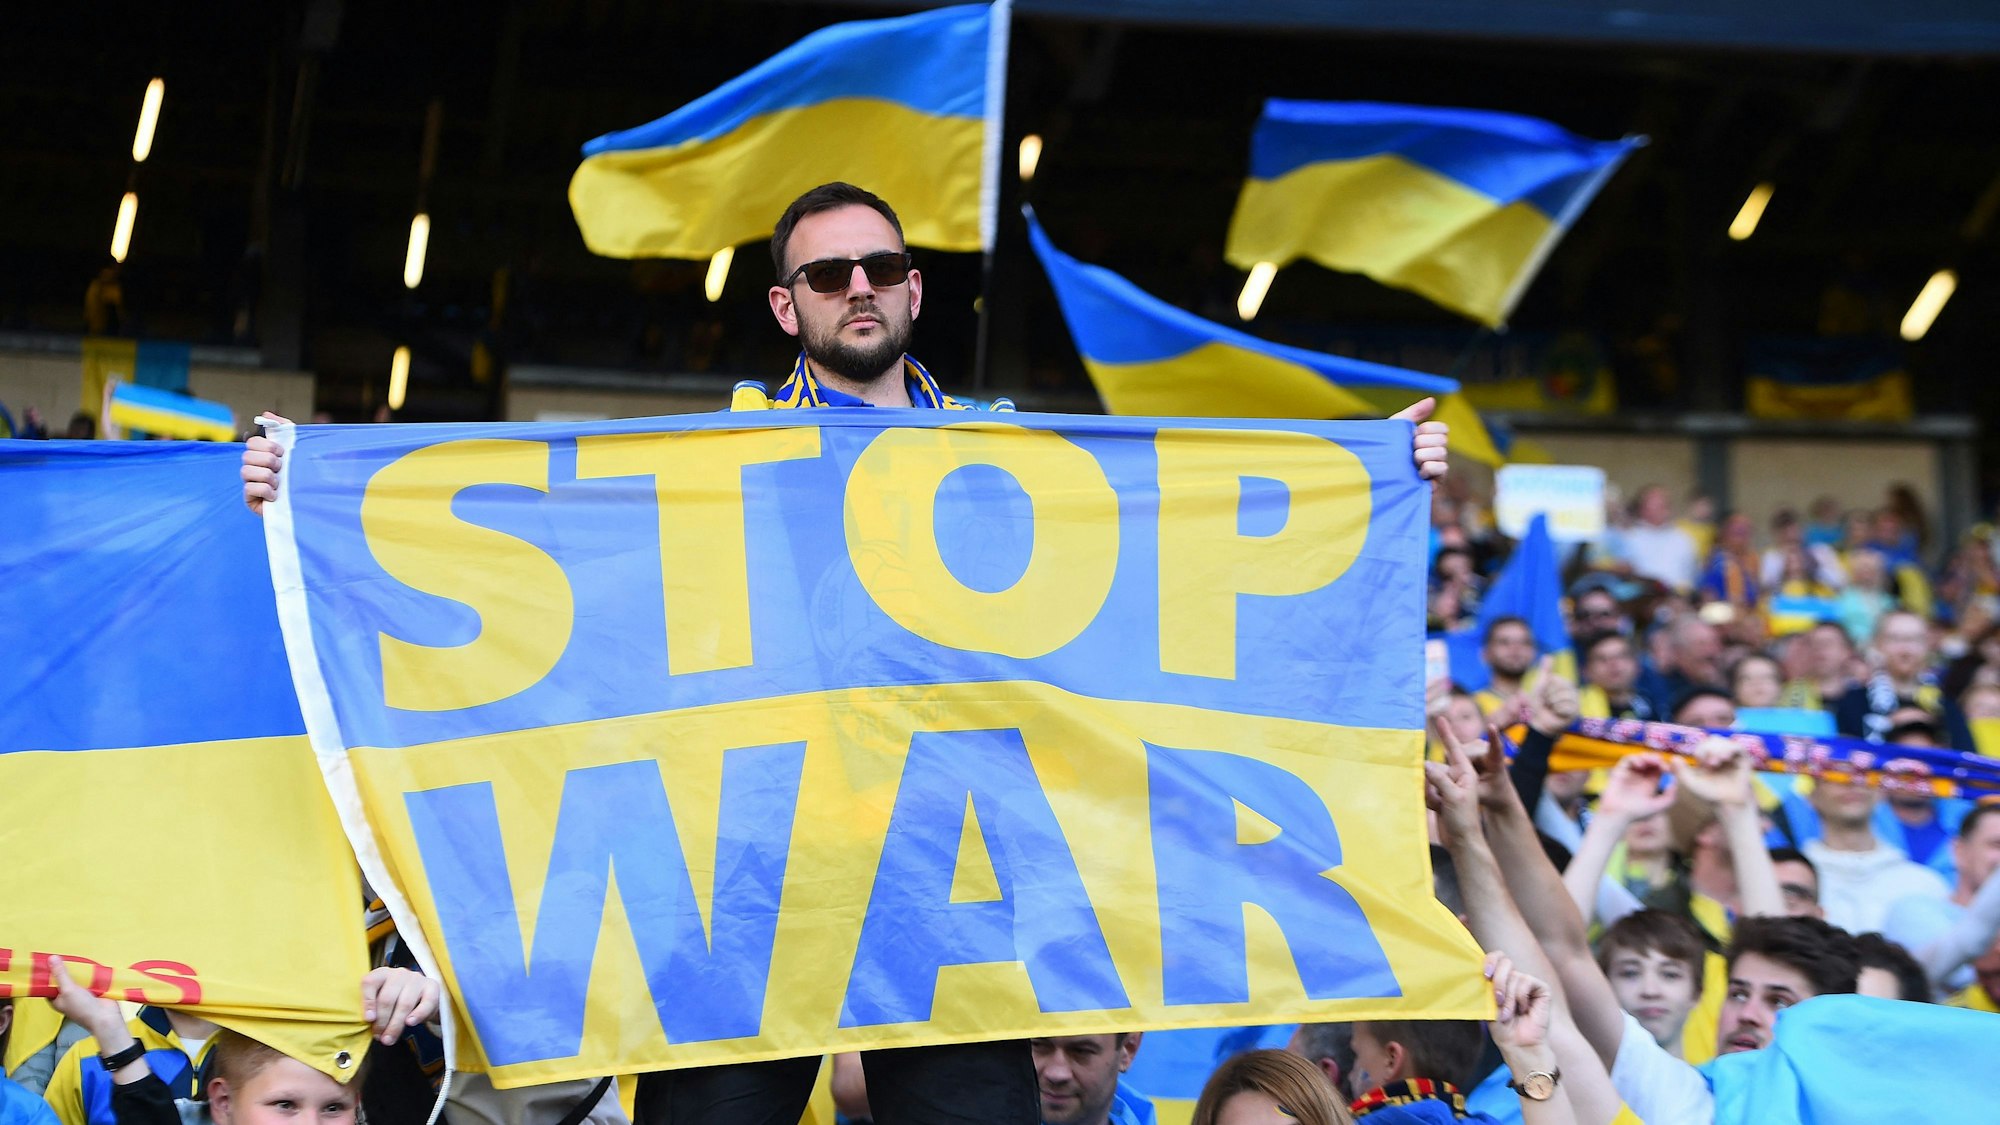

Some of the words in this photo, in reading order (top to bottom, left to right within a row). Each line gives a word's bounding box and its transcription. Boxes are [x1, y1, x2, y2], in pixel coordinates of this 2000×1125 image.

[361, 425, 1373, 711] STOP
[0, 948, 202, 1004] DS
[403, 728, 1403, 1067] WAR
